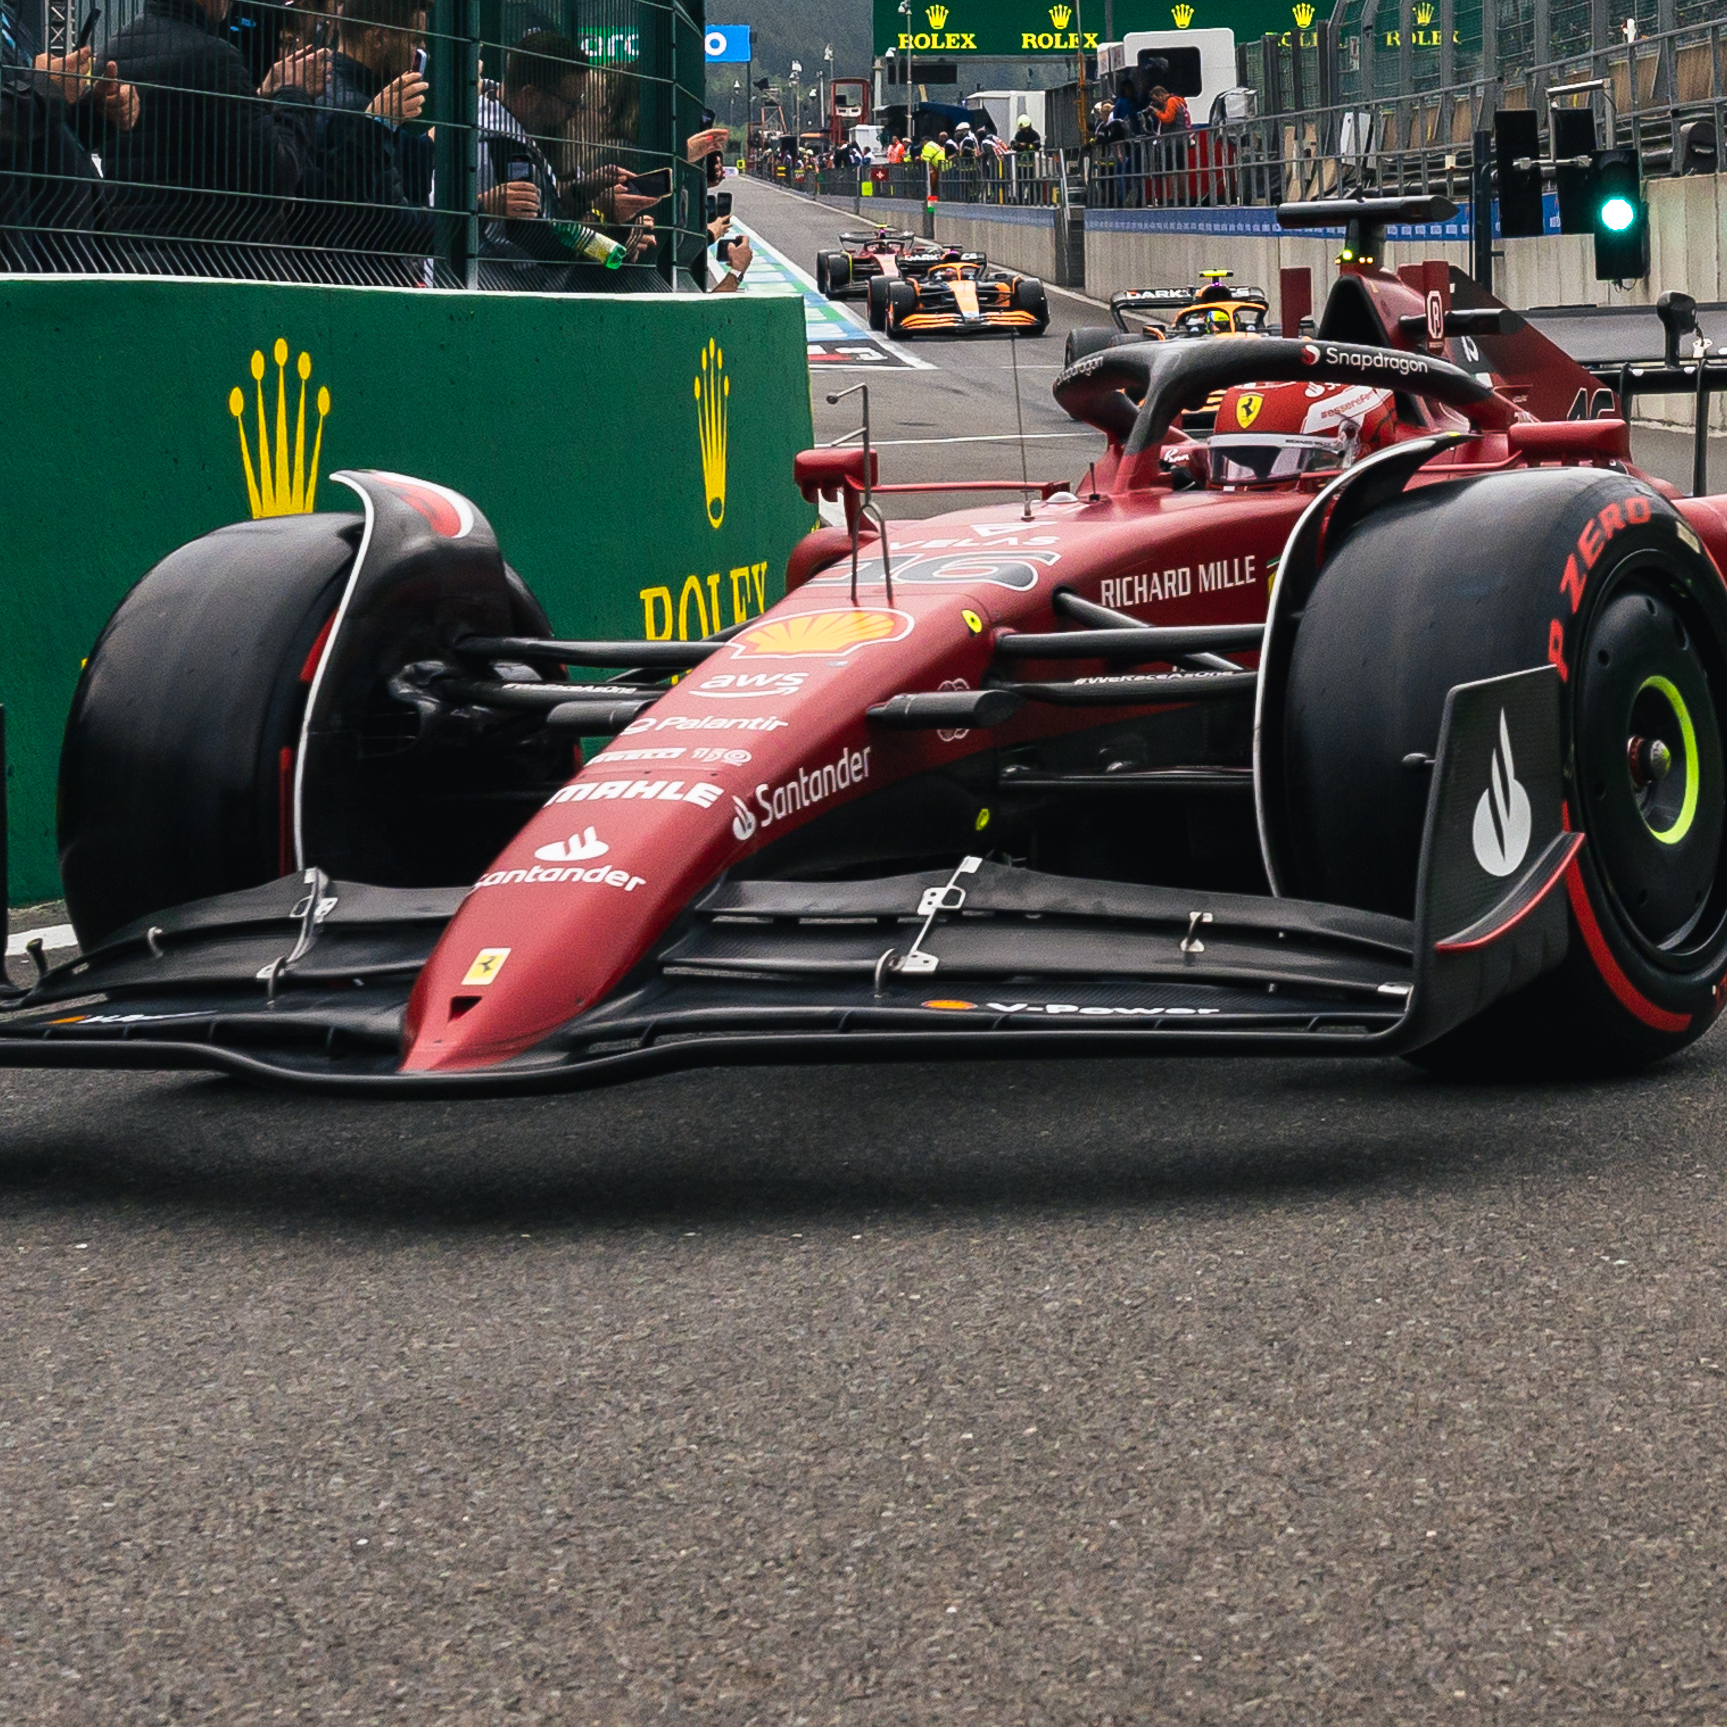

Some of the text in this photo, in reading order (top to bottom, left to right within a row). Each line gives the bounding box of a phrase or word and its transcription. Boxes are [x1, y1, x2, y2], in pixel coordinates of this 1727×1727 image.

[898, 33, 977, 49] ROLEX
[1021, 33, 1099, 49] ROLEX
[1326, 347, 1428, 376] Snapdragon
[889, 536, 1061, 551] VELAS
[1101, 555, 1256, 608] RICHARD MILLE
[699, 672, 810, 689] aws
[653, 715, 789, 732] Palantir
[543, 780, 724, 809] MAHLE
[755, 746, 871, 828] Santander
[986, 1002, 1221, 1015] V-Power
